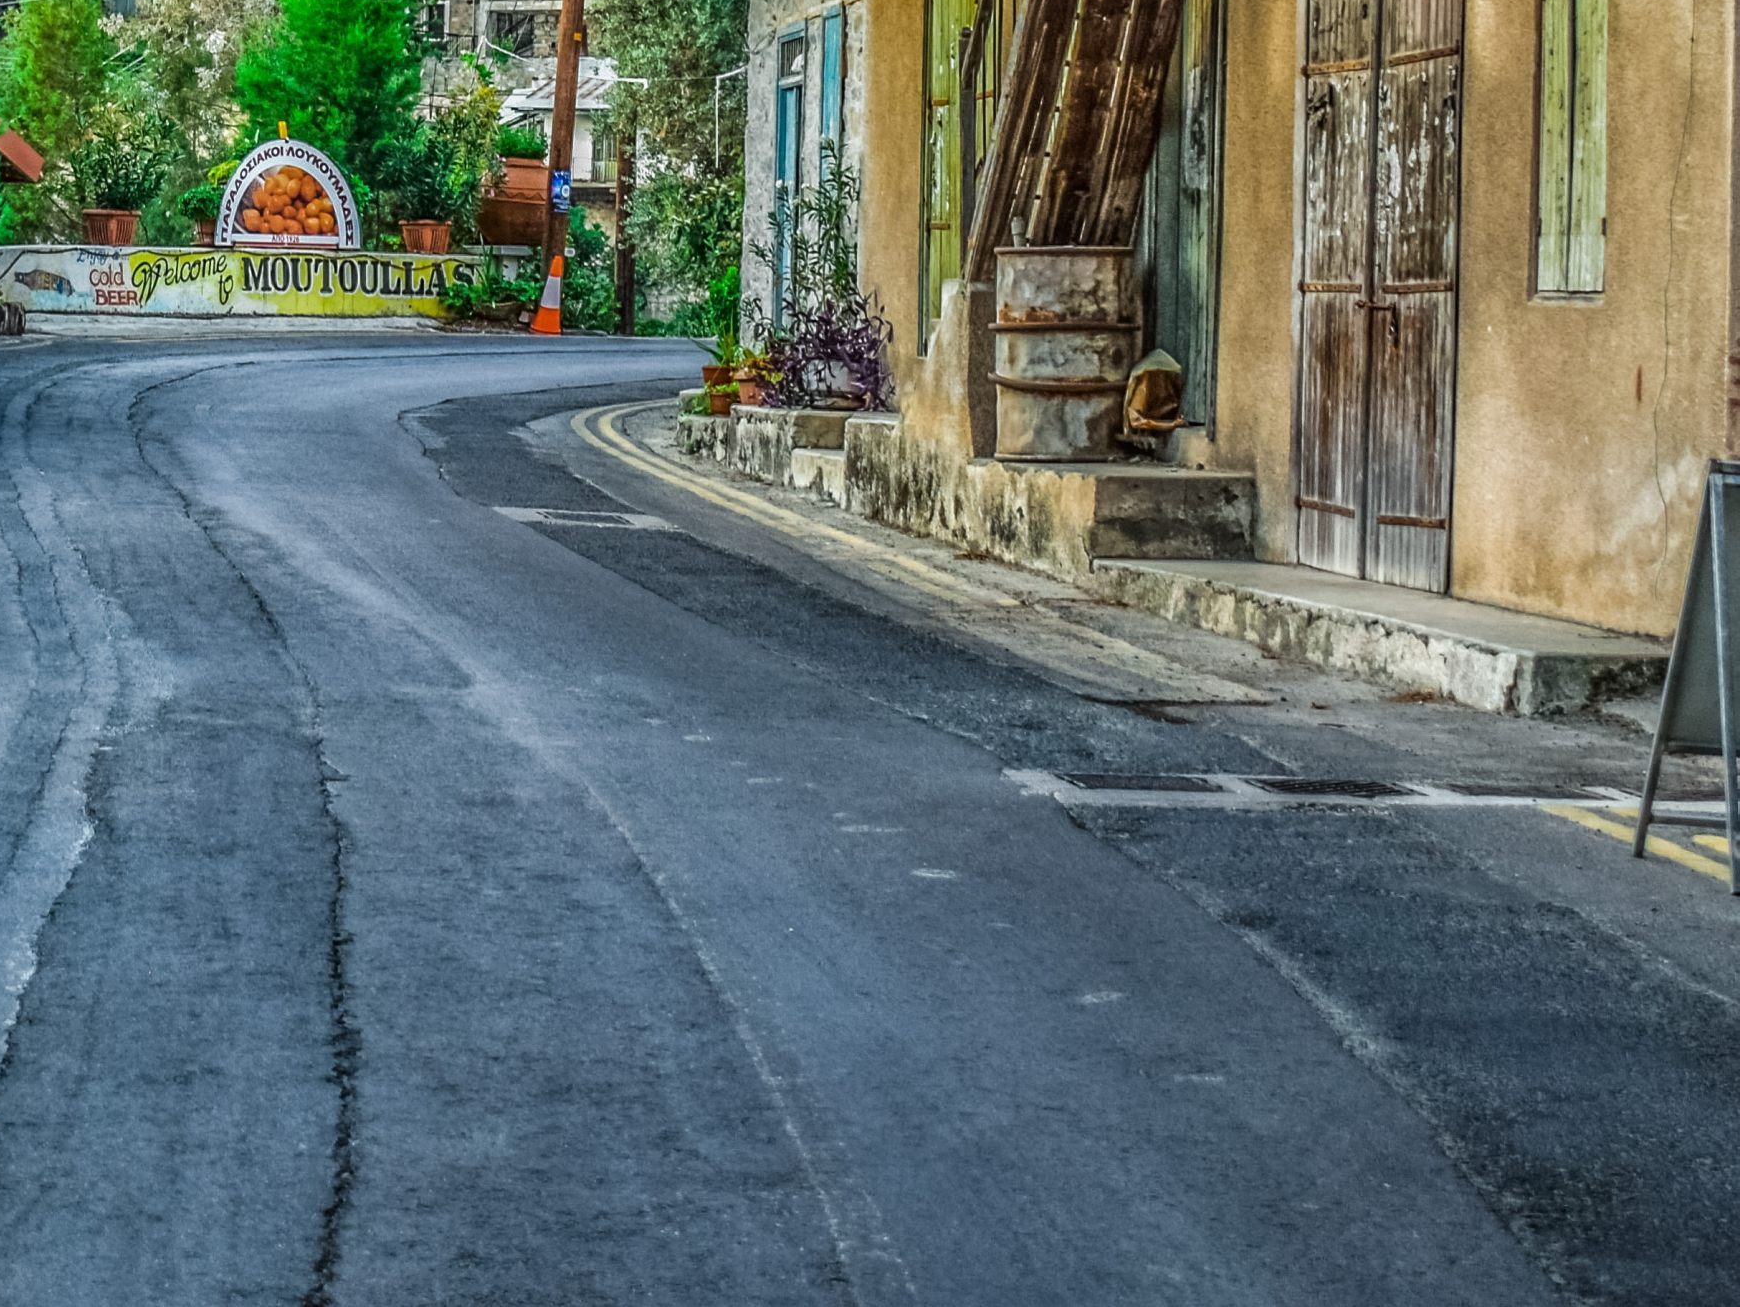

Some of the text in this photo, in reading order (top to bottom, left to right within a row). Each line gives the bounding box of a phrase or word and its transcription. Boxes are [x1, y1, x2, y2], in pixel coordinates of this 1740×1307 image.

[221, 147, 354, 246] ΠΑΡΑΔΟΣΙΑΚΟΙ ΛΟΥΚΟΥΜΑΔΕΣ
[95, 289, 138, 306] BEER
[131, 254, 227, 305] Welcome
[218, 274, 234, 305] to
